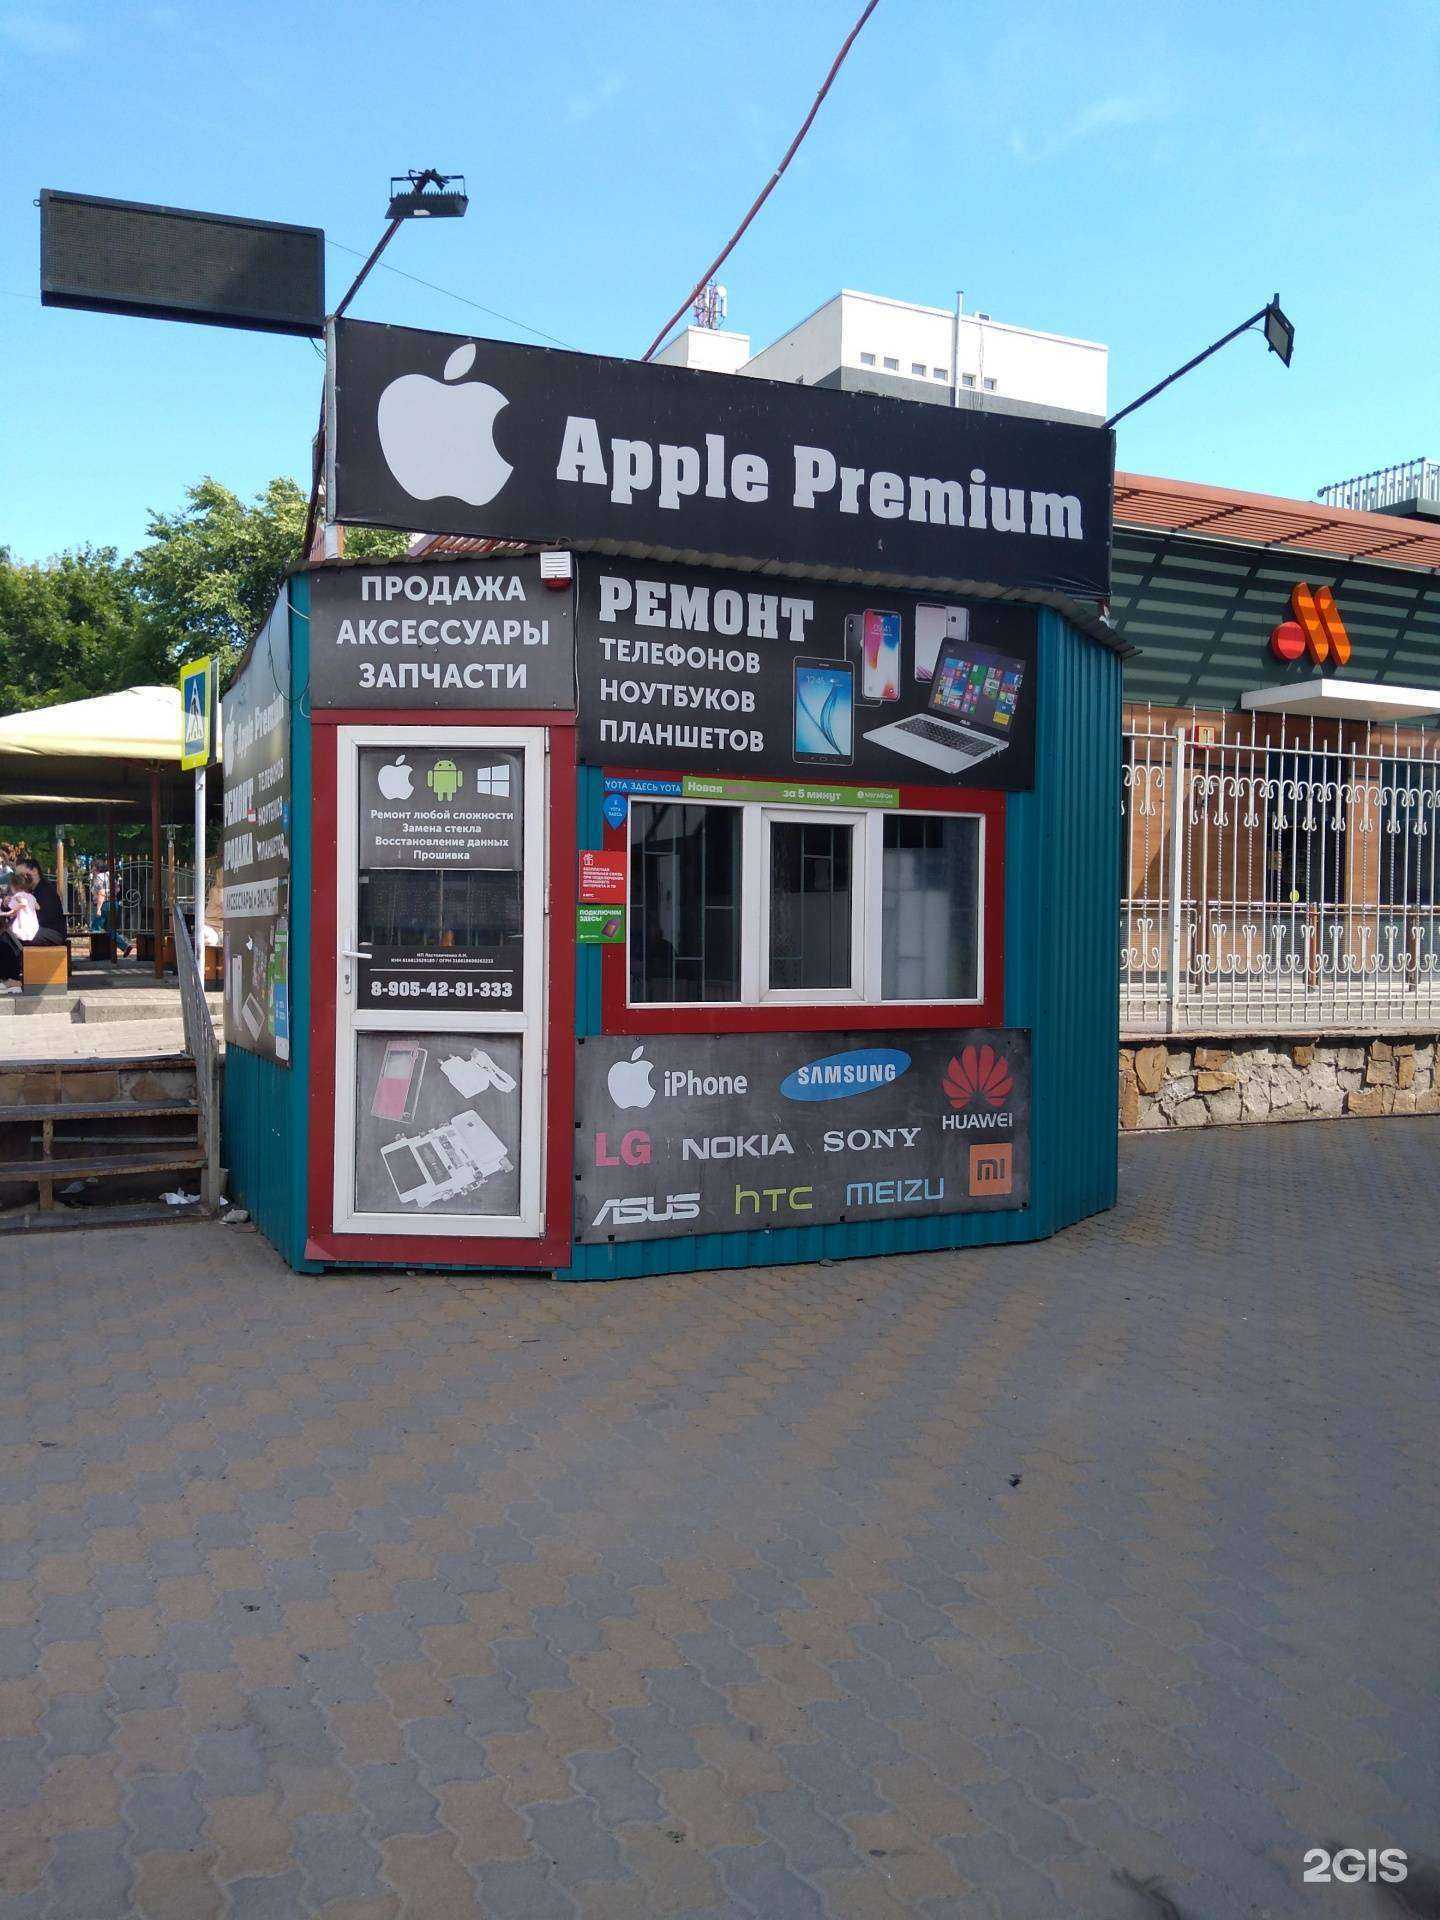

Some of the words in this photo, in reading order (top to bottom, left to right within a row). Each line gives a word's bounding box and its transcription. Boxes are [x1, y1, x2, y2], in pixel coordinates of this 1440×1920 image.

[556, 415, 769, 510] Apple
[793, 444, 1083, 540] Premium
[361, 575, 527, 605] ПРОДАЖА
[599, 575, 814, 642] РЕМОНТ
[336, 619, 549, 645] АКСЕССУАРЫ
[599, 637, 761, 674] ТЕЛЕФОНОВ
[358, 663, 527, 689] ЗАПЧАСТИ
[600, 678, 756, 713] НОУТБУКОВ
[600, 719, 765, 752] ПЛАНШЕТОВ
[605, 780, 628, 790] YOTA
[630, 783, 658, 792] ЗДЕСЬ
[660, 784, 682, 793] YOTA
[687, 782, 723, 793] Новая
[797, 788, 805, 799] 5
[806, 792, 842, 802] минут
[370, 810, 411, 820] Ремонт
[414, 810, 450, 820] любой
[453, 811, 514, 821] сложности
[402, 823, 442, 833] Замена
[444, 824, 482, 833] стекла
[375, 836, 465, 847] Восстановление
[467, 838, 509, 848] данных
[413, 850, 470, 861] Прошивка
[371, 981, 513, 997] 8-905-42-81-333
[664, 1070, 748, 1097] iPhone
[798, 1063, 897, 1086] SAMSUNG
[942, 1112, 1013, 1130] HUAWEI
[594, 1129, 653, 1168] LG
[682, 1133, 795, 1161] NOKIA
[823, 1127, 922, 1153] SONY
[592, 1192, 701, 1226] ASUS
[846, 1178, 945, 1206] MEIZU
